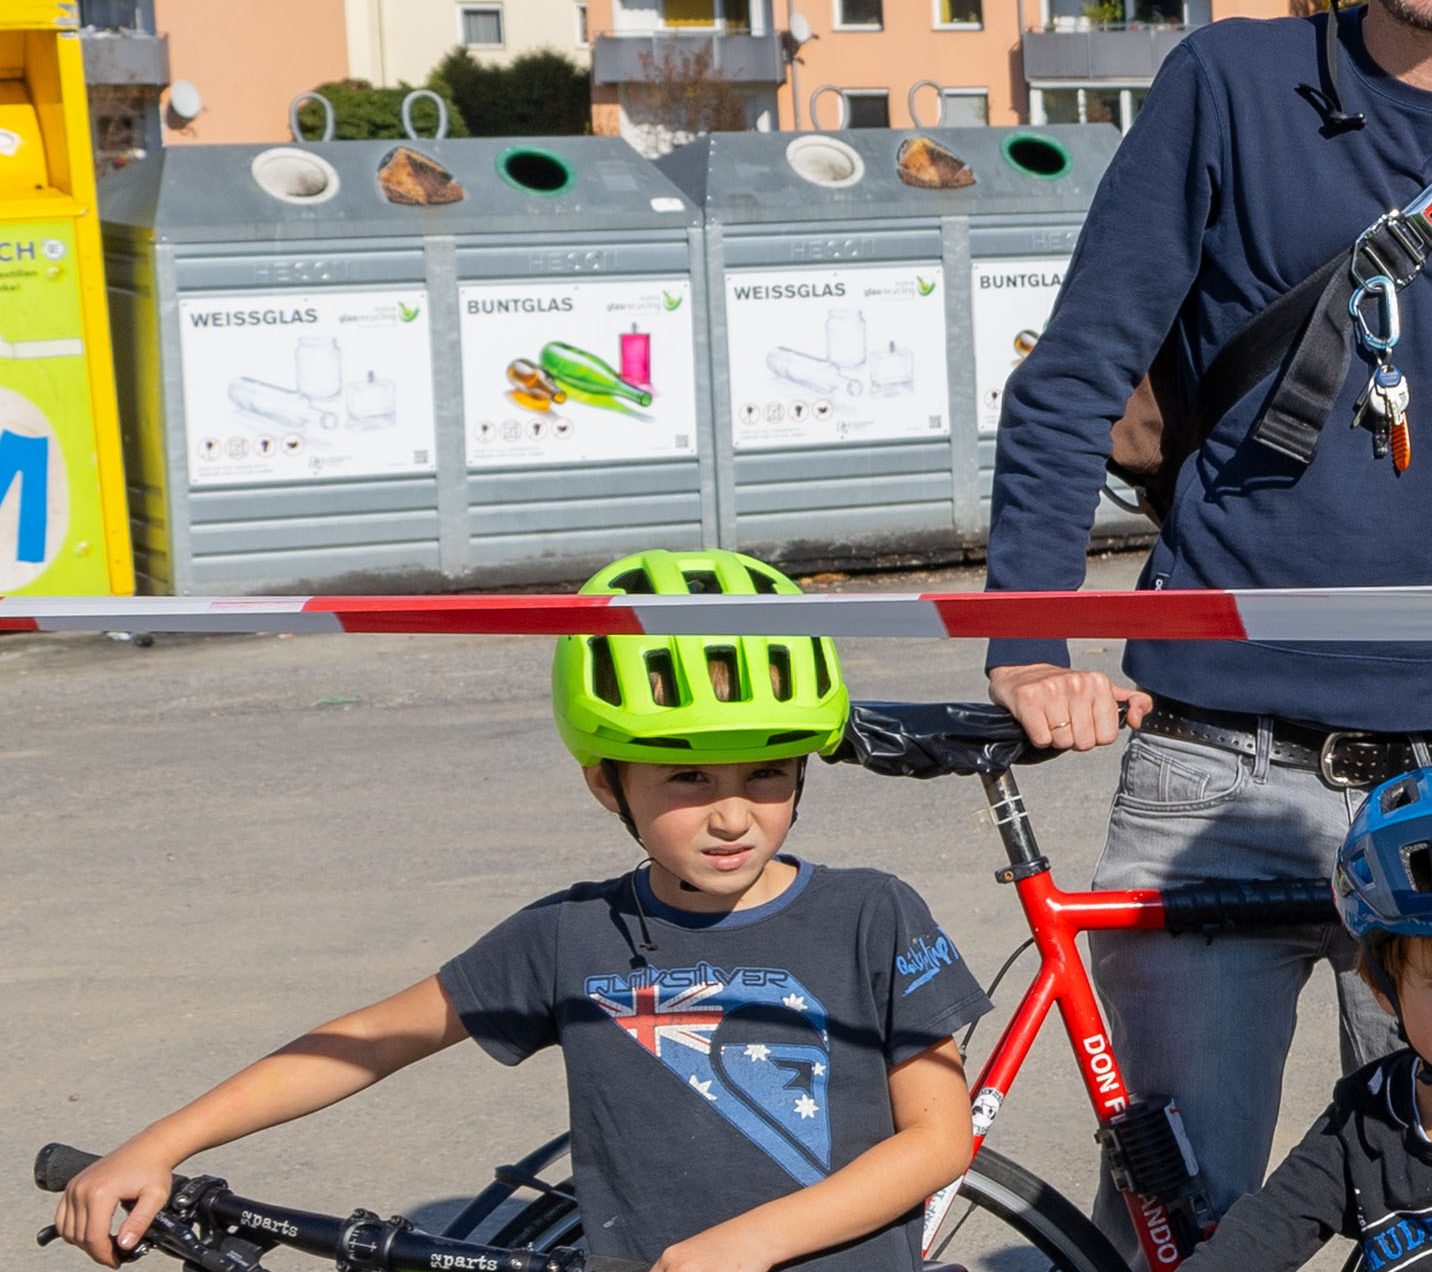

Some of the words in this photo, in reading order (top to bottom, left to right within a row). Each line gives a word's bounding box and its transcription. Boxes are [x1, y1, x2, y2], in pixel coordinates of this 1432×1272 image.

[979, 273, 1063, 289] BUNTGLA
[734, 282, 846, 301] WEISSGLAS
[467, 296, 574, 315] BUNTGLAS
[190, 308, 318, 328] WEISSGLAS
[1083, 1033, 1120, 1094] DON
